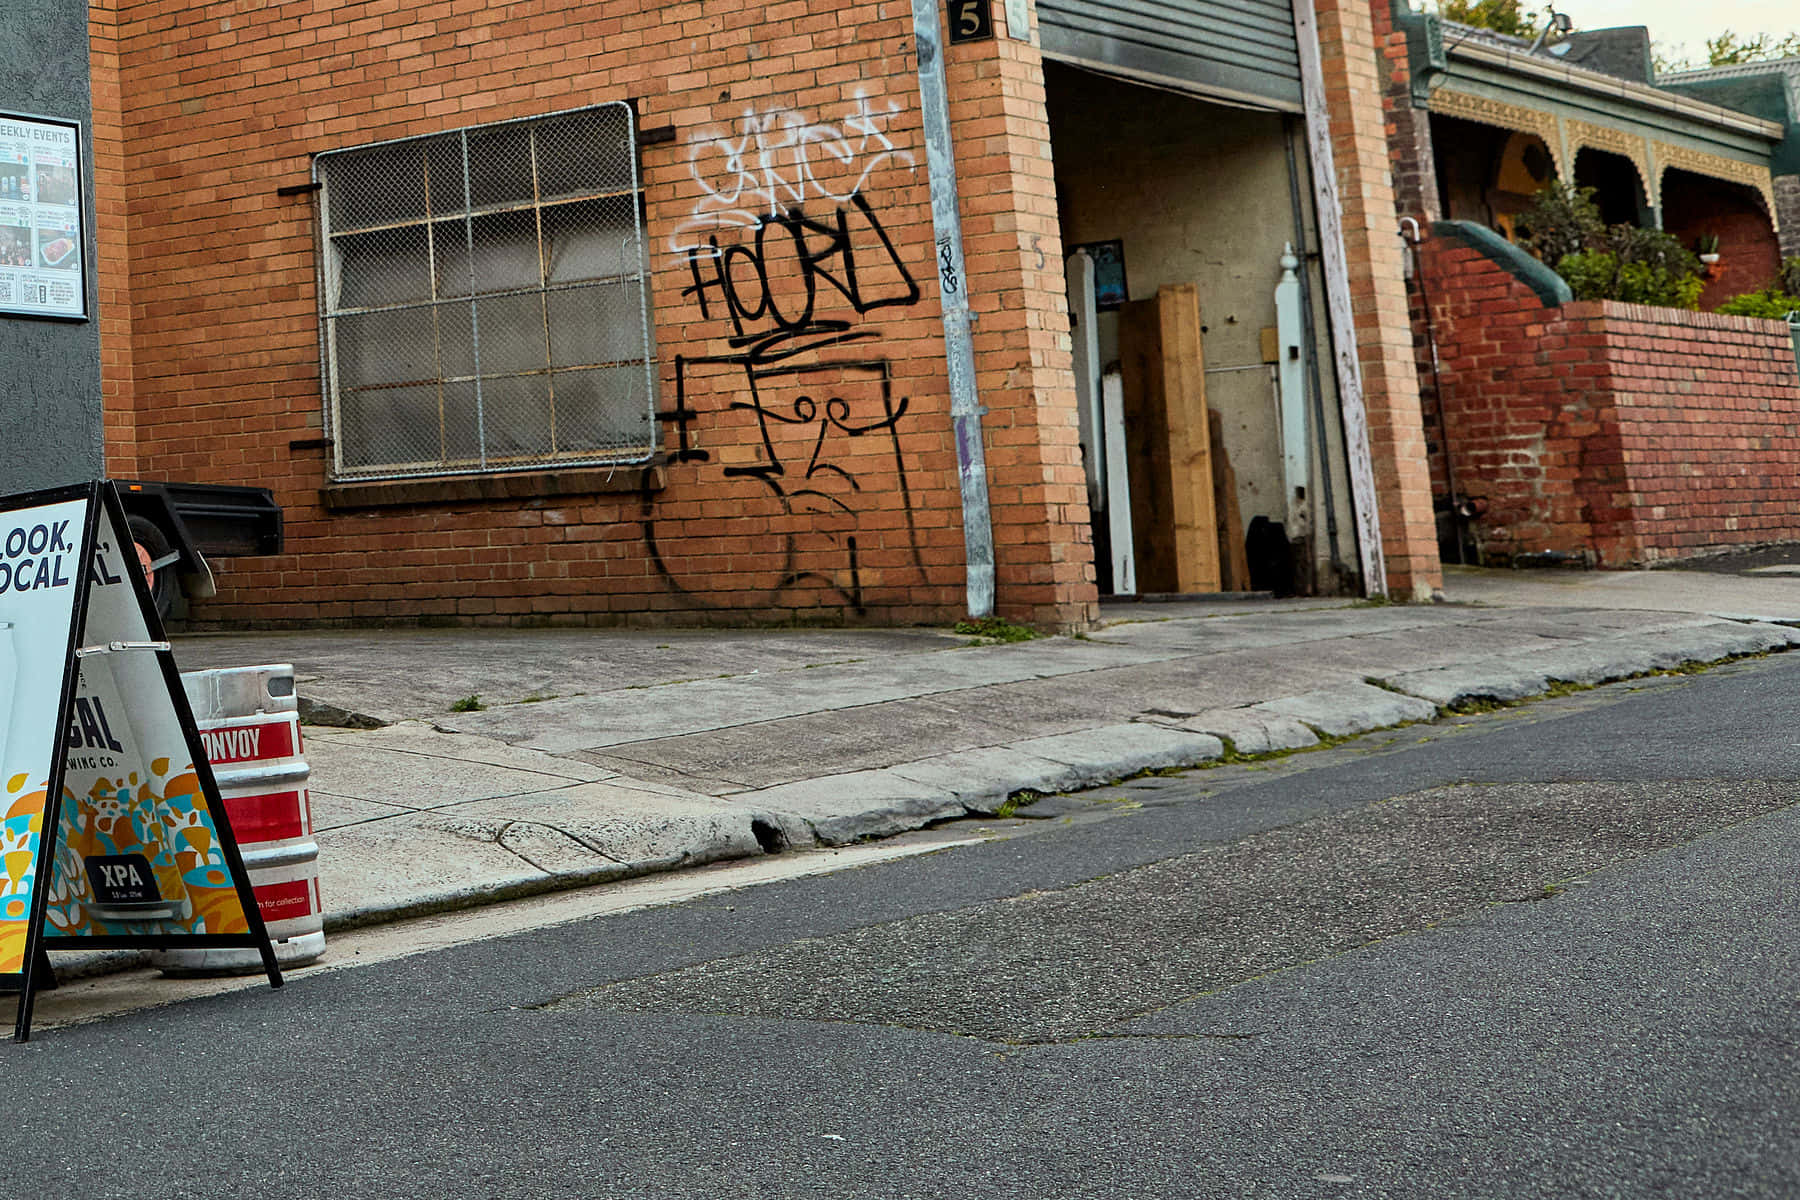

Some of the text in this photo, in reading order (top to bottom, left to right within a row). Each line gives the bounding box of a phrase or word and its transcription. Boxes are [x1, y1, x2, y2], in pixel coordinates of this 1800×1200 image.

[960, 1, 980, 35] 5
[33, 127, 70, 143] EVENTS
[201, 728, 260, 761] ONVOY
[99, 864, 143, 887] XPA
[265, 900, 275, 909] for
[276, 896, 305, 907] collection
